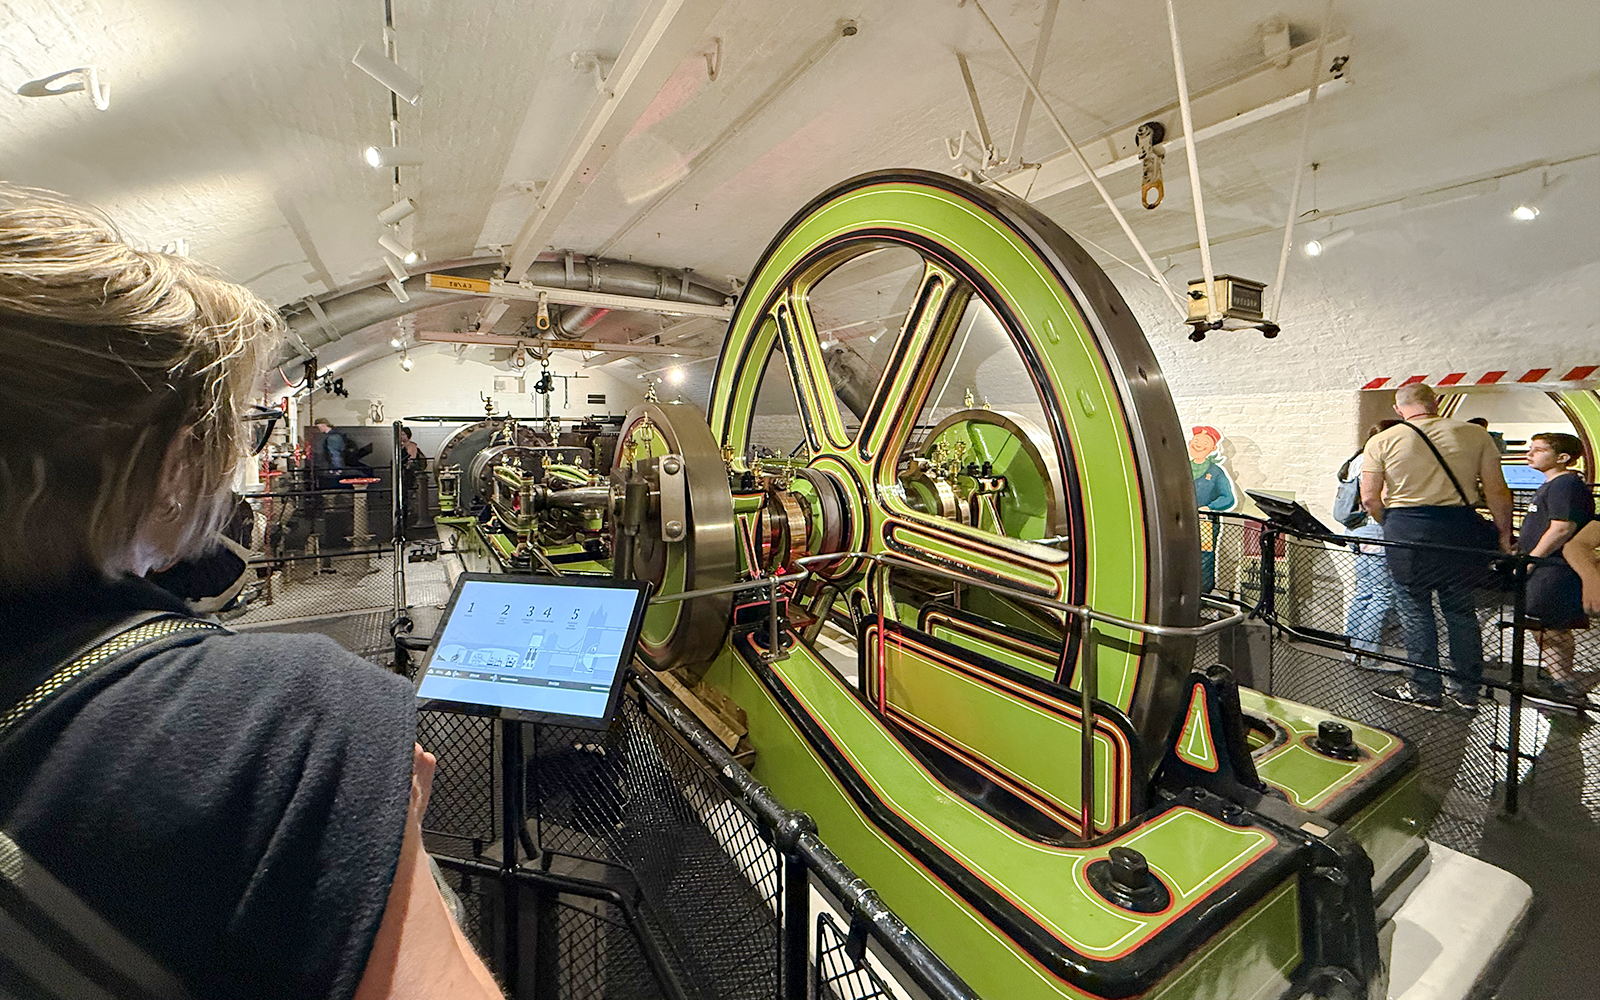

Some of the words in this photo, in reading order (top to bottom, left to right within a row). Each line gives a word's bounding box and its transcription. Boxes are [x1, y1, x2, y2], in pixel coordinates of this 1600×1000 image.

[467, 602, 475, 613] 1
[501, 604, 511, 616] 2
[526, 605, 535, 617] 3
[543, 607, 553, 618] 4
[571, 608, 580, 620] 5
